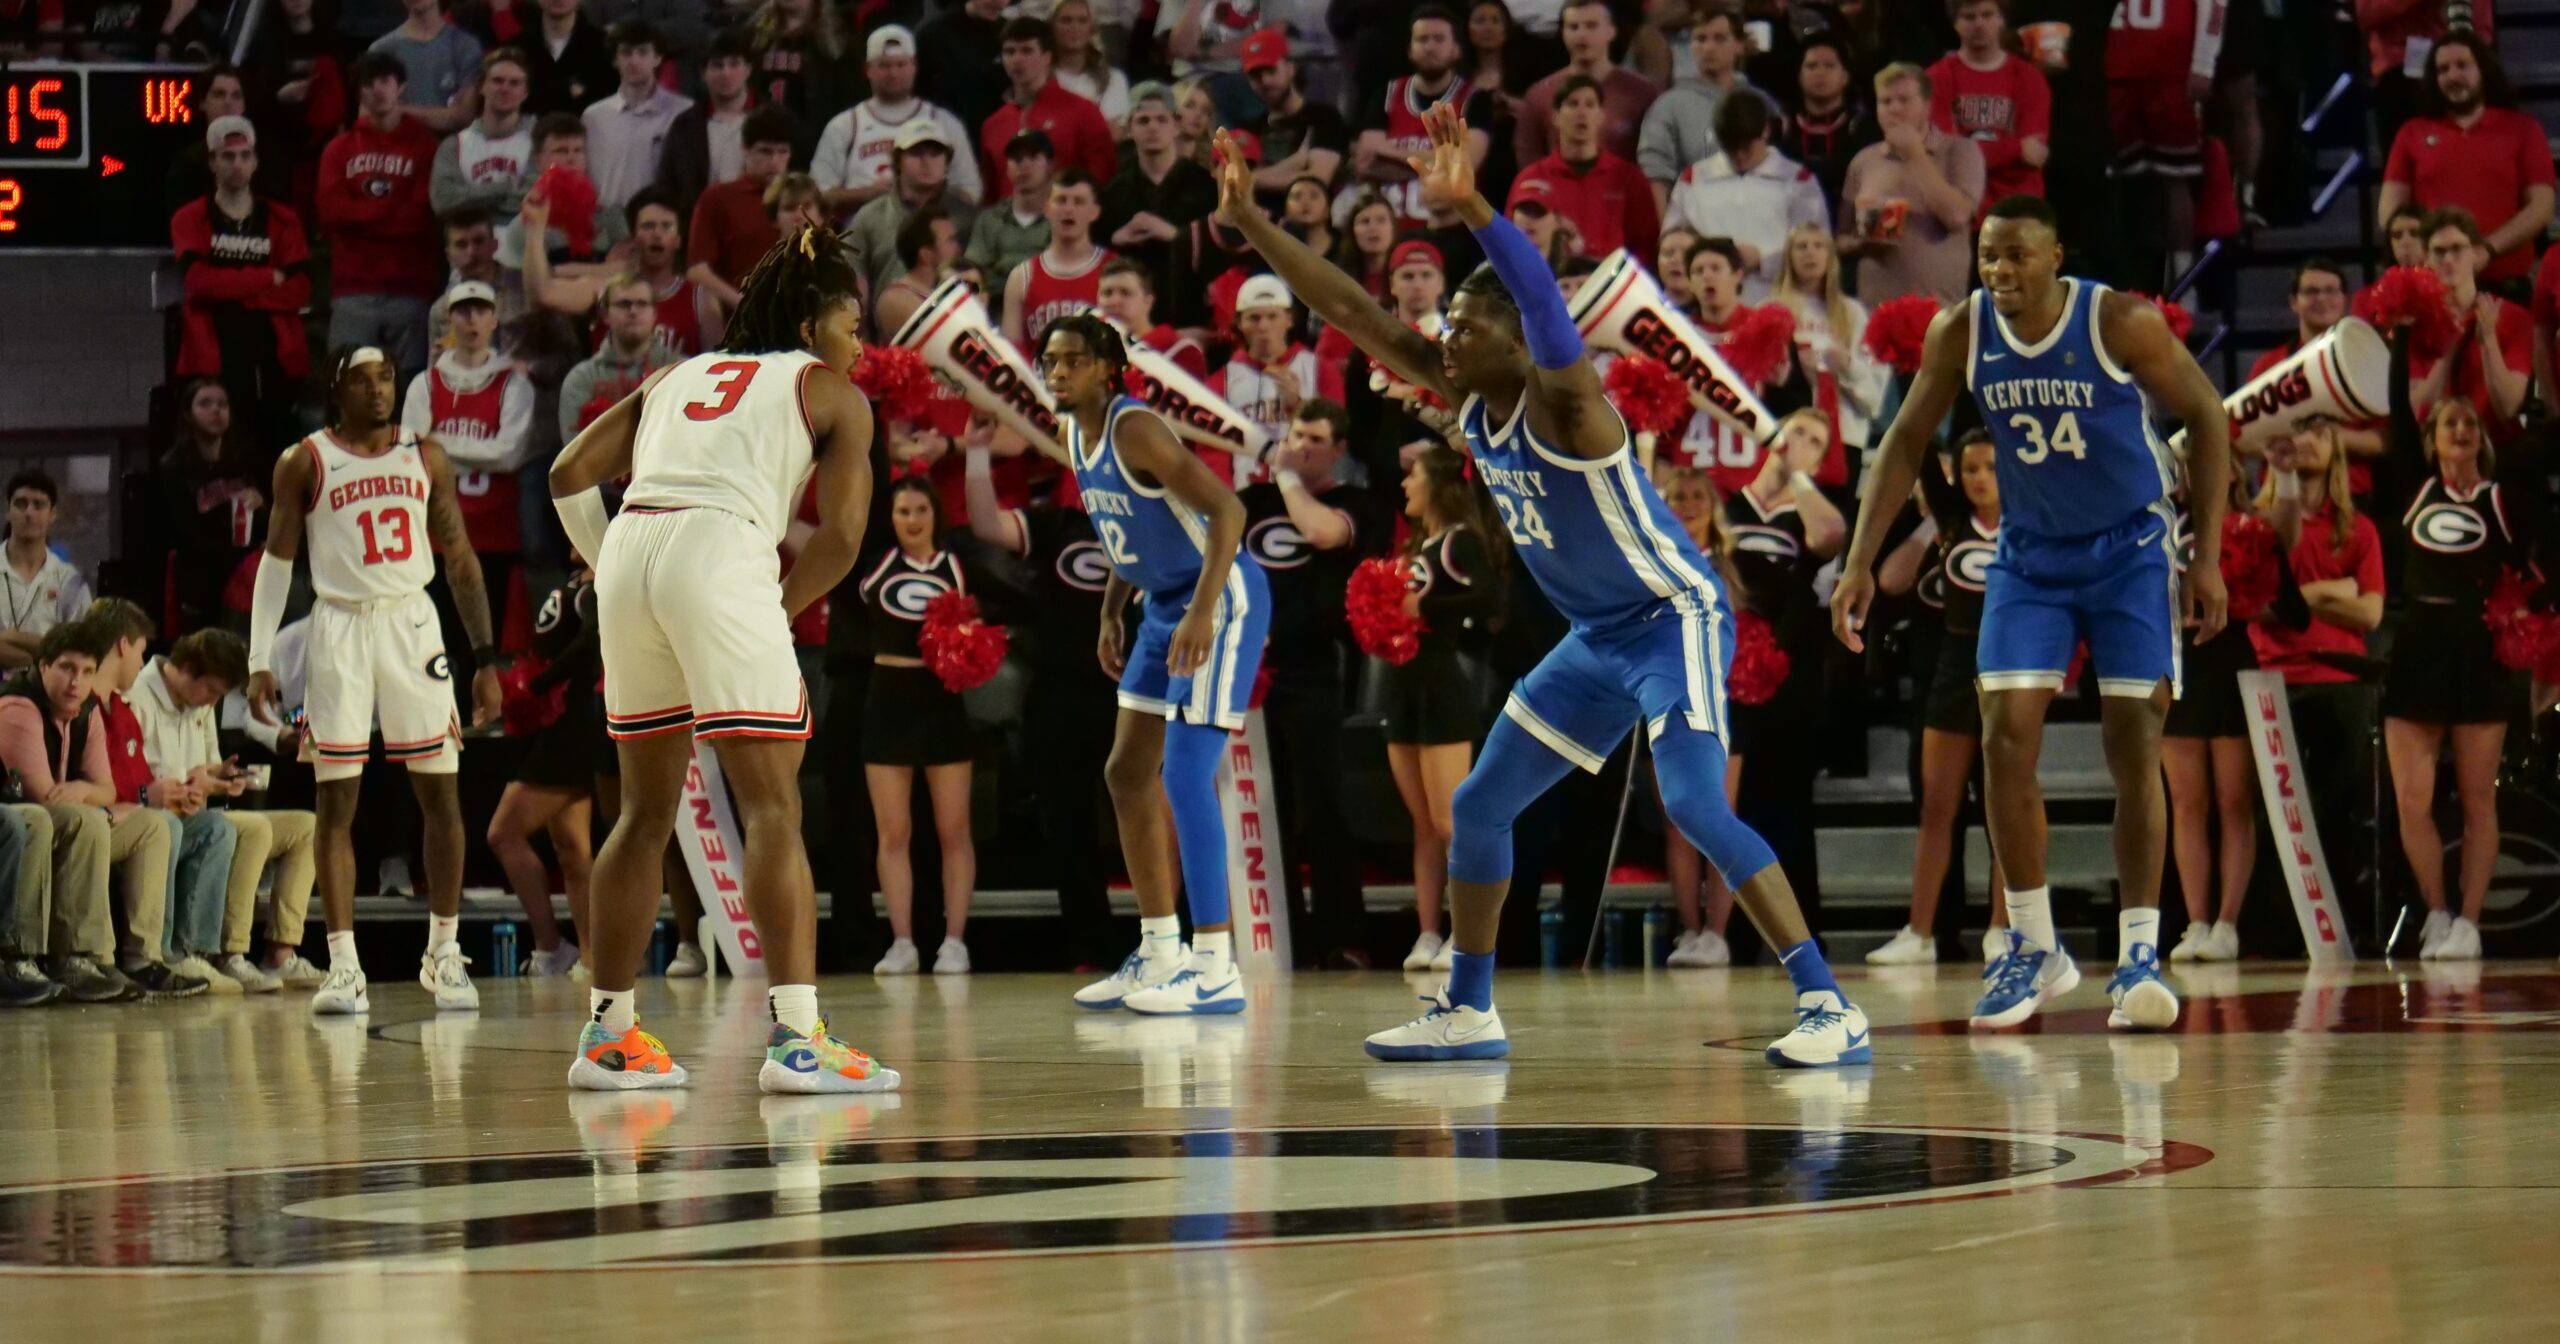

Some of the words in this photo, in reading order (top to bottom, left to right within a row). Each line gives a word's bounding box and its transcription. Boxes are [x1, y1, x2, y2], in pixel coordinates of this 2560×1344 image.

[144, 79, 192, 124] UK
[683, 361, 761, 421] 3
[947, 327, 1059, 437] GEORG
[1623, 307, 1757, 431] GEORGIA
[1982, 377, 2094, 412] KENTUCKY
[1146, 376, 1245, 448] ORGIA
[2008, 411, 2088, 465] 34
[329, 475, 425, 513] GEORGIA
[1494, 494, 1555, 550] 24
[356, 507, 413, 566] 13
[1098, 519, 1139, 565] 12
[2257, 692, 2337, 942] DEFENSE
[685, 747, 763, 959] DEFENS
